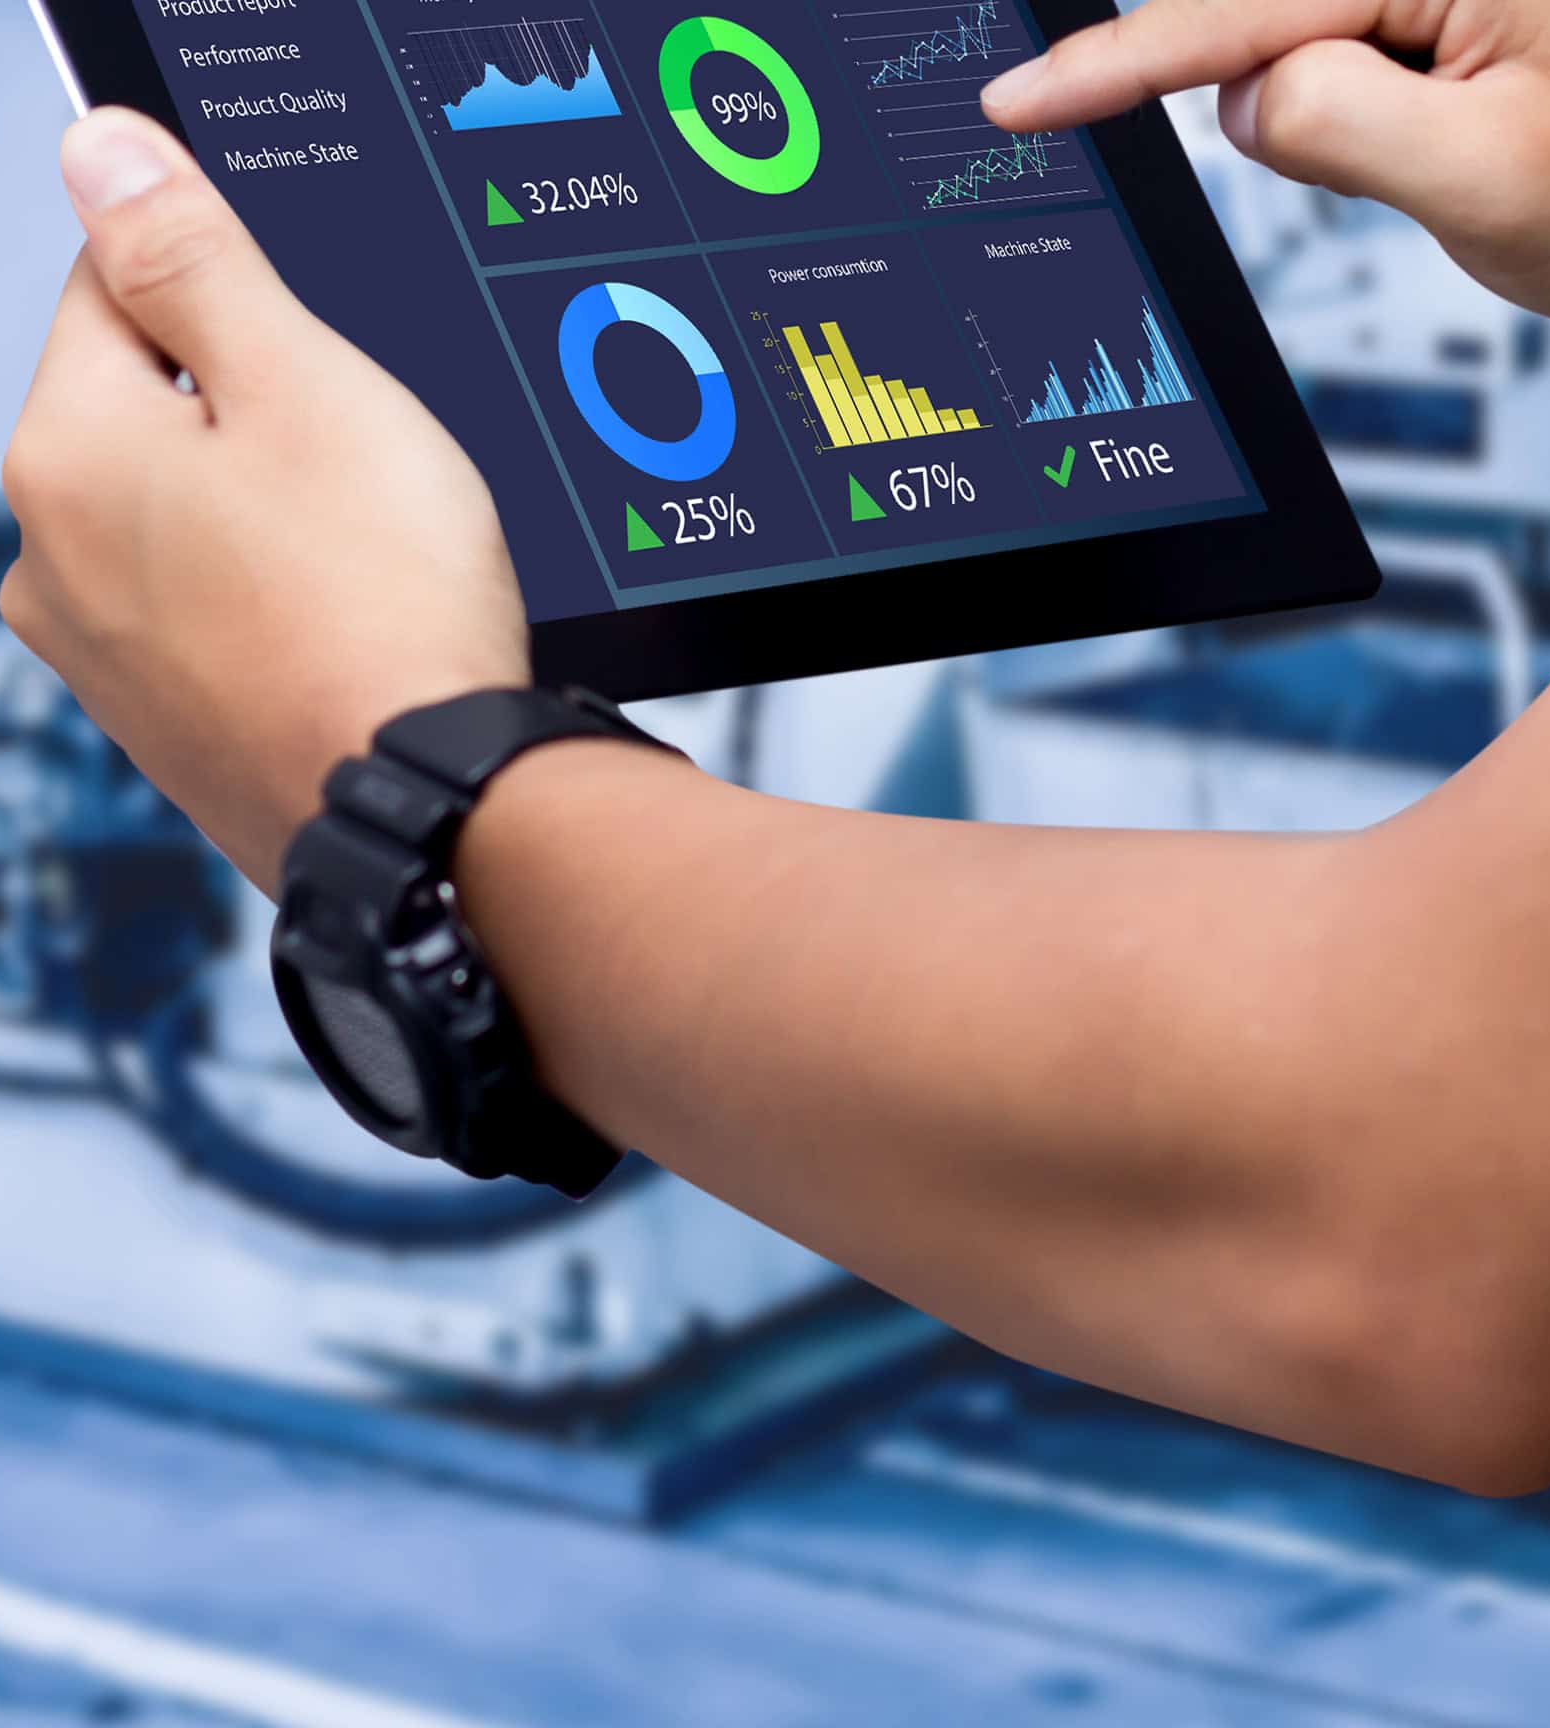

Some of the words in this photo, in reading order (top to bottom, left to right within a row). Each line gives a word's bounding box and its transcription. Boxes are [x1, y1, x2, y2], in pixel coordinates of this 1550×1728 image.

[179, 43, 301, 68] Performance
[200, 95, 279, 120] Product
[279, 88, 346, 114] Quality
[711, 90, 777, 125] 99%
[224, 147, 309, 172] Machine
[308, 142, 359, 164] State
[521, 172, 638, 216] 32.04%
[983, 240, 1039, 260] Machine
[1038, 237, 1072, 253] State
[767, 268, 810, 284] Power
[811, 257, 889, 279] consumtion
[1088, 437, 1175, 483] Fine
[888, 461, 977, 512] 67%
[661, 492, 756, 545] 25%
